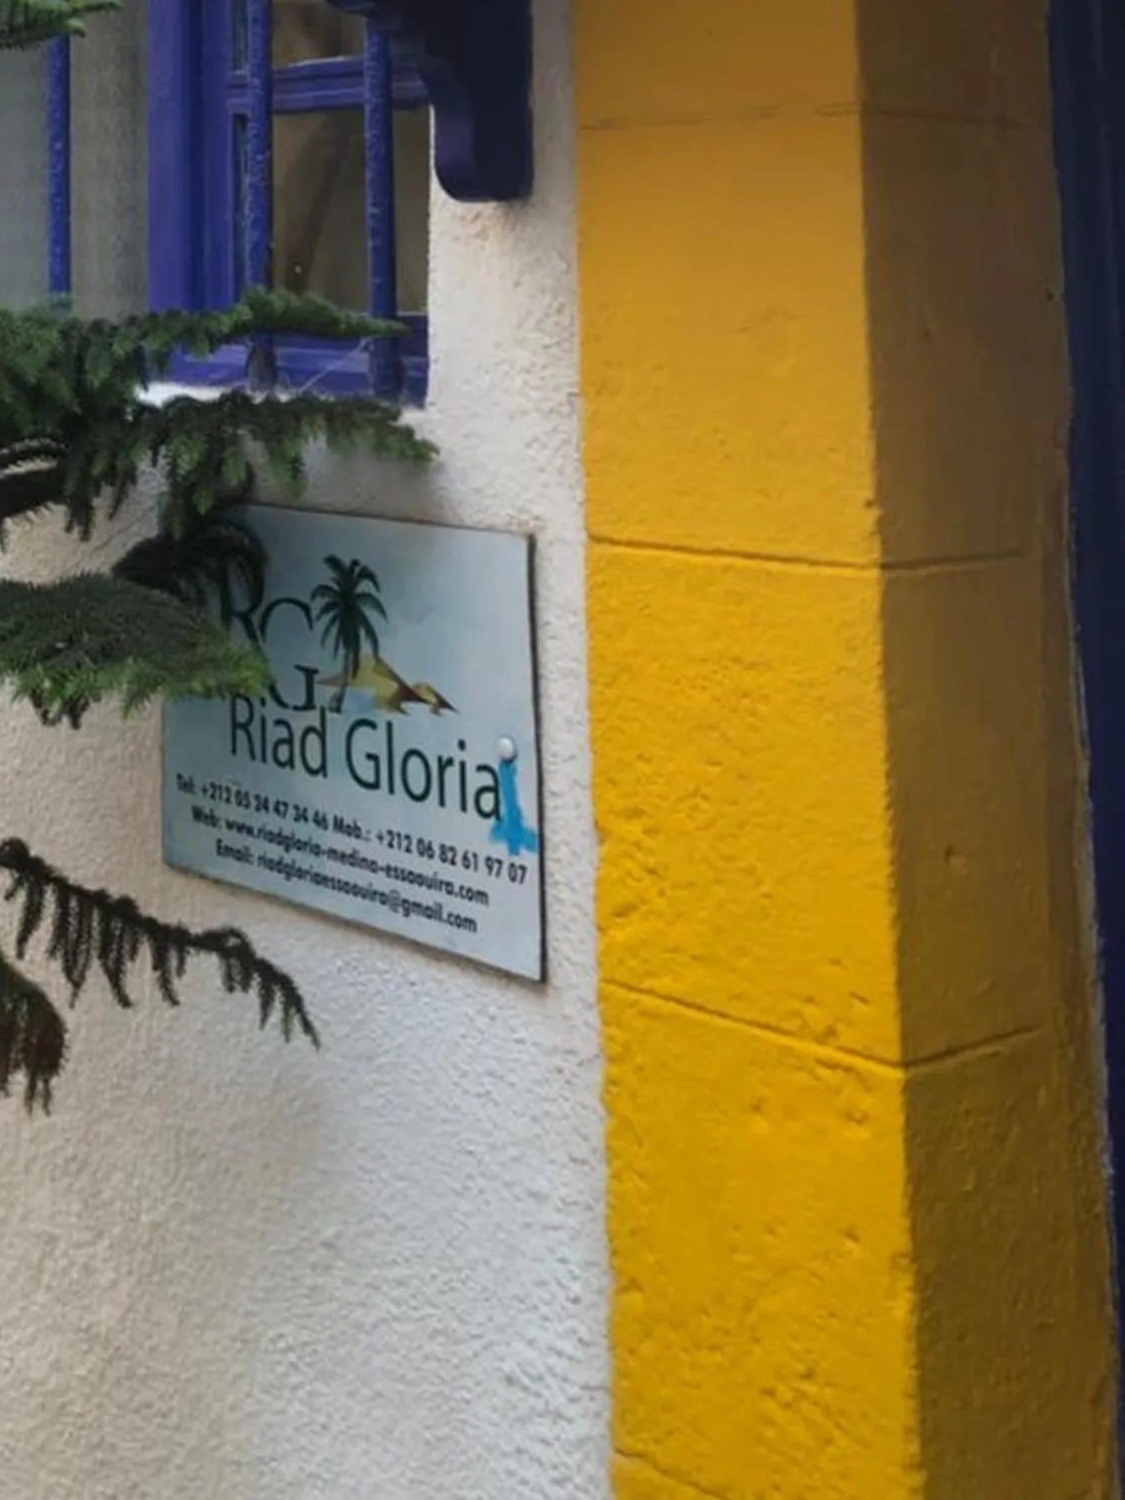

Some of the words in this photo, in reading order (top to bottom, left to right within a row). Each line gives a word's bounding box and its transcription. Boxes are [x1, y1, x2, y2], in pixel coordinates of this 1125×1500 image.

[229, 695, 328, 779] Riad
[345, 717, 502, 822] Gloria
[191, 804, 221, 829] Web:
[201, 781, 232, 804] +212
[234, 789, 251, 811] 05
[273, 799, 289, 819] 47
[312, 809, 329, 831] 46
[376, 829, 413, 854] +212
[416, 837, 435, 860] 06
[439, 843, 458, 867] 82
[461, 849, 479, 873] 61
[484, 855, 504, 879] 97
[507, 861, 528, 885] 07
[216, 838, 254, 866] Email:
[257, 851, 478, 933] riadgloriaessaouira@gmail.com
